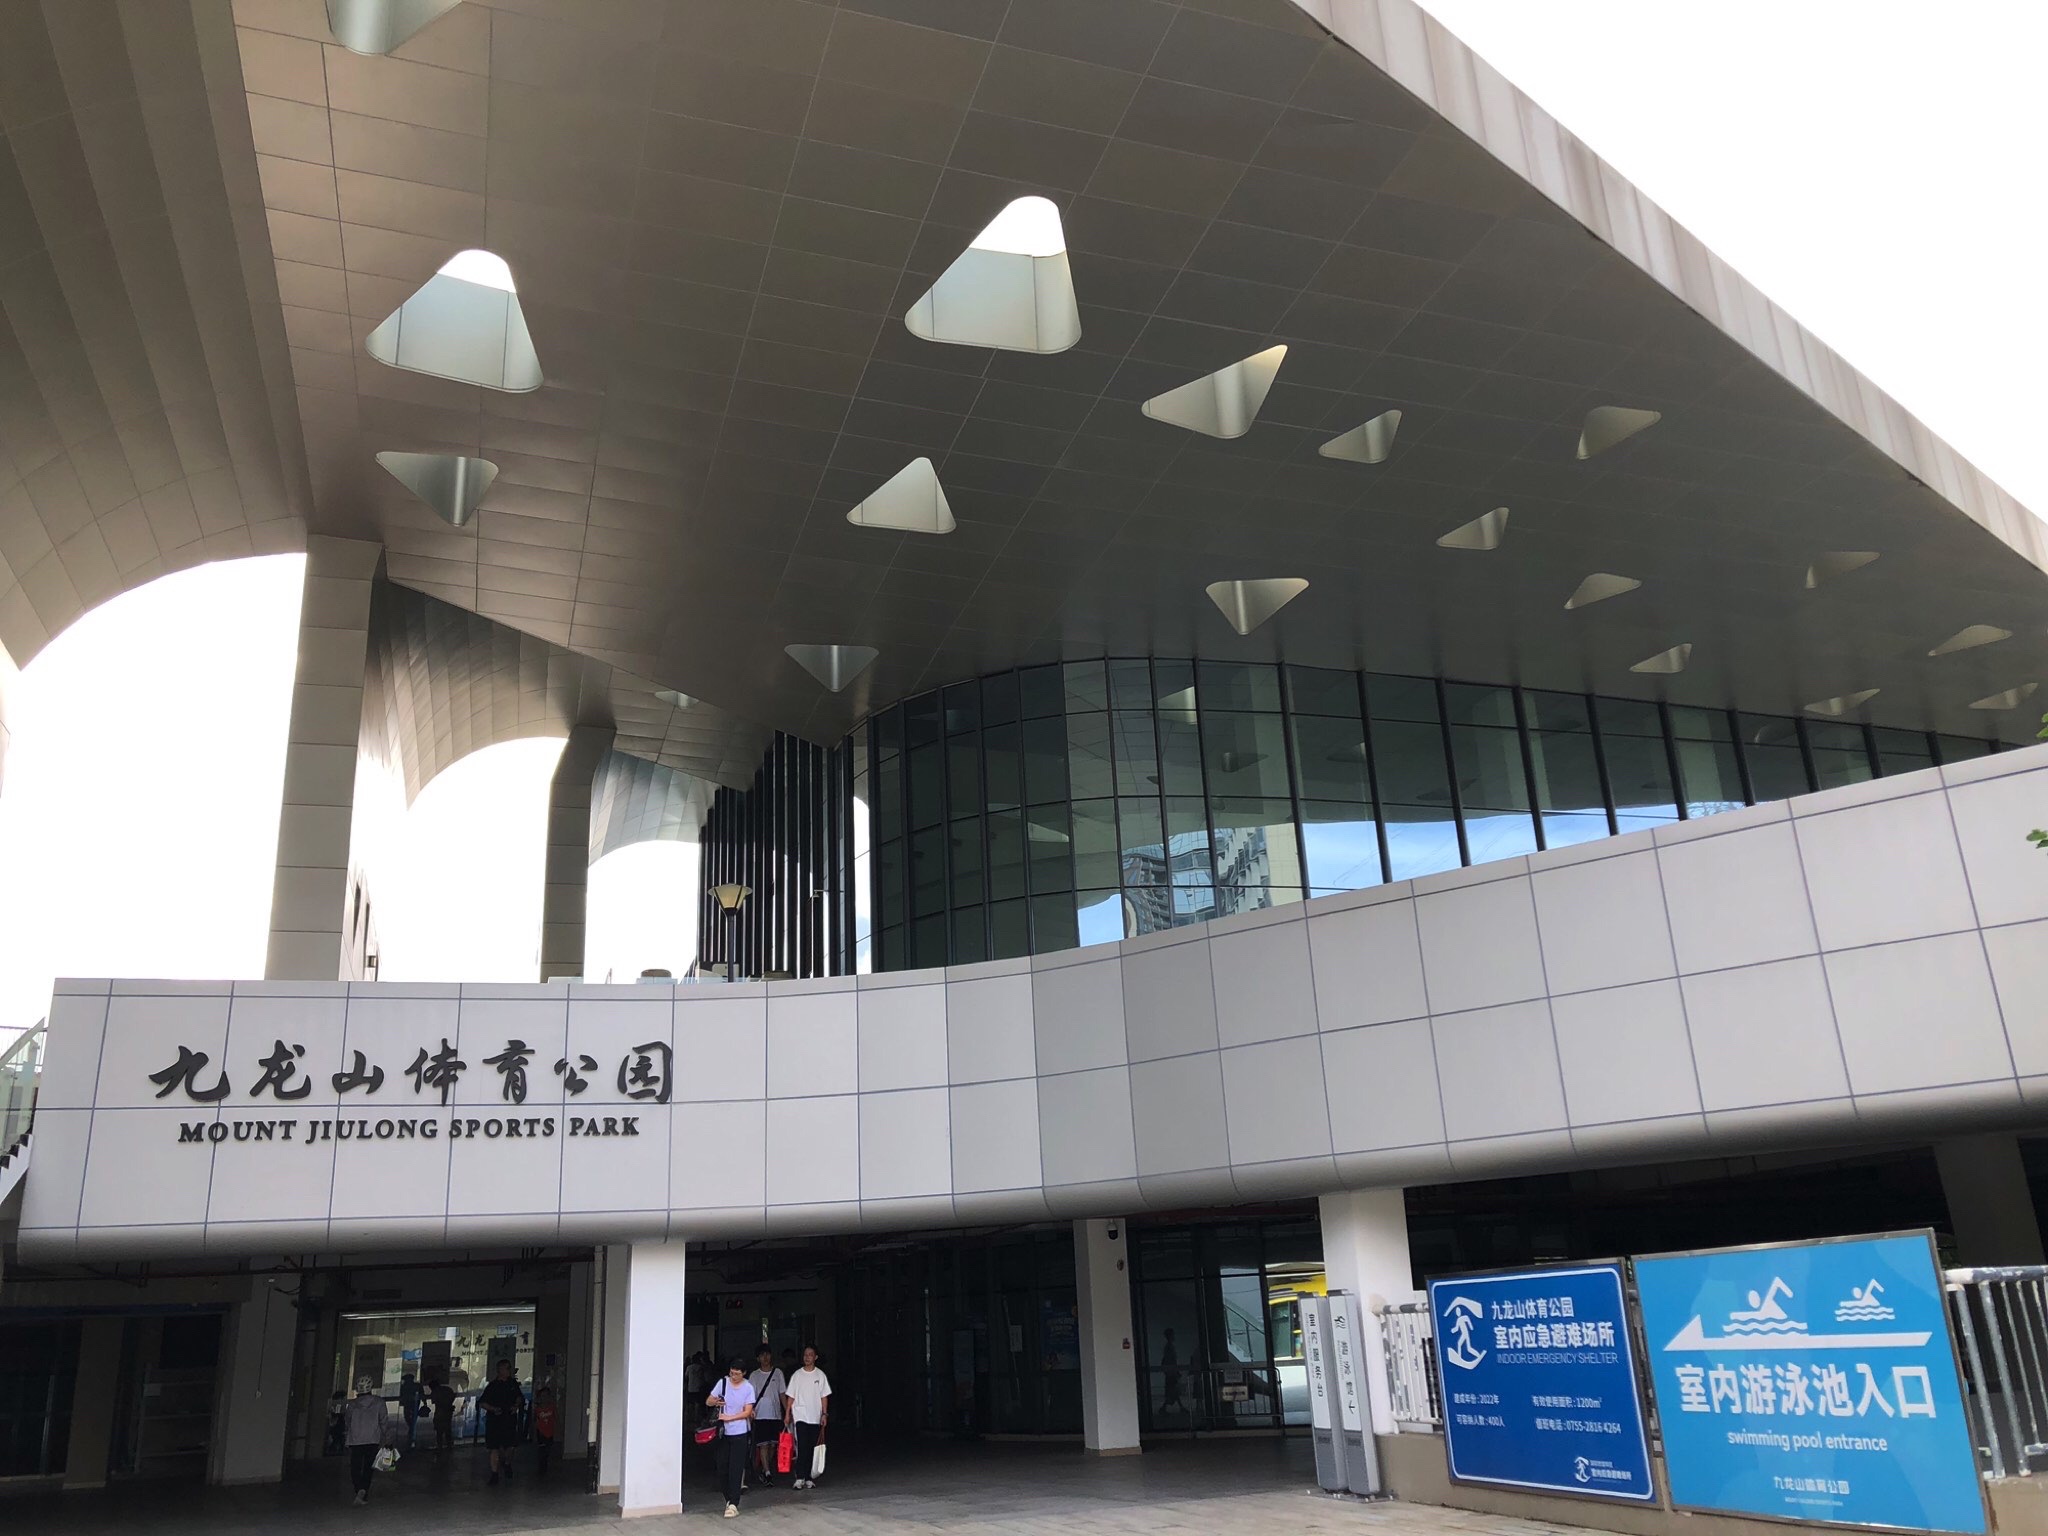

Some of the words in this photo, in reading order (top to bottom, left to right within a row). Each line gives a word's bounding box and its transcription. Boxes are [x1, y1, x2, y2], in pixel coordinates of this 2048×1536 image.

[148, 1038, 673, 1106] 九龙山体育公园
[178, 1120, 297, 1143] MOUNT
[305, 1119, 439, 1145] JIULONG
[448, 1117, 556, 1140] SPORTS
[568, 1116, 641, 1137] PARK
[1491, 1297, 1575, 1320] 九龙山体育公园
[1493, 1322, 1615, 1349] 室内应急避难场所
[1496, 1353, 1527, 1364] INDOOR
[1527, 1353, 1577, 1364] EMERGENCY
[1578, 1352, 1619, 1364] SHELTER
[1675, 1363, 1937, 1418] 室内游泳池入口
[1727, 1428, 1790, 1451] swimming
[1792, 1431, 1822, 1452] pool
[1825, 1432, 1888, 1451] entrance
